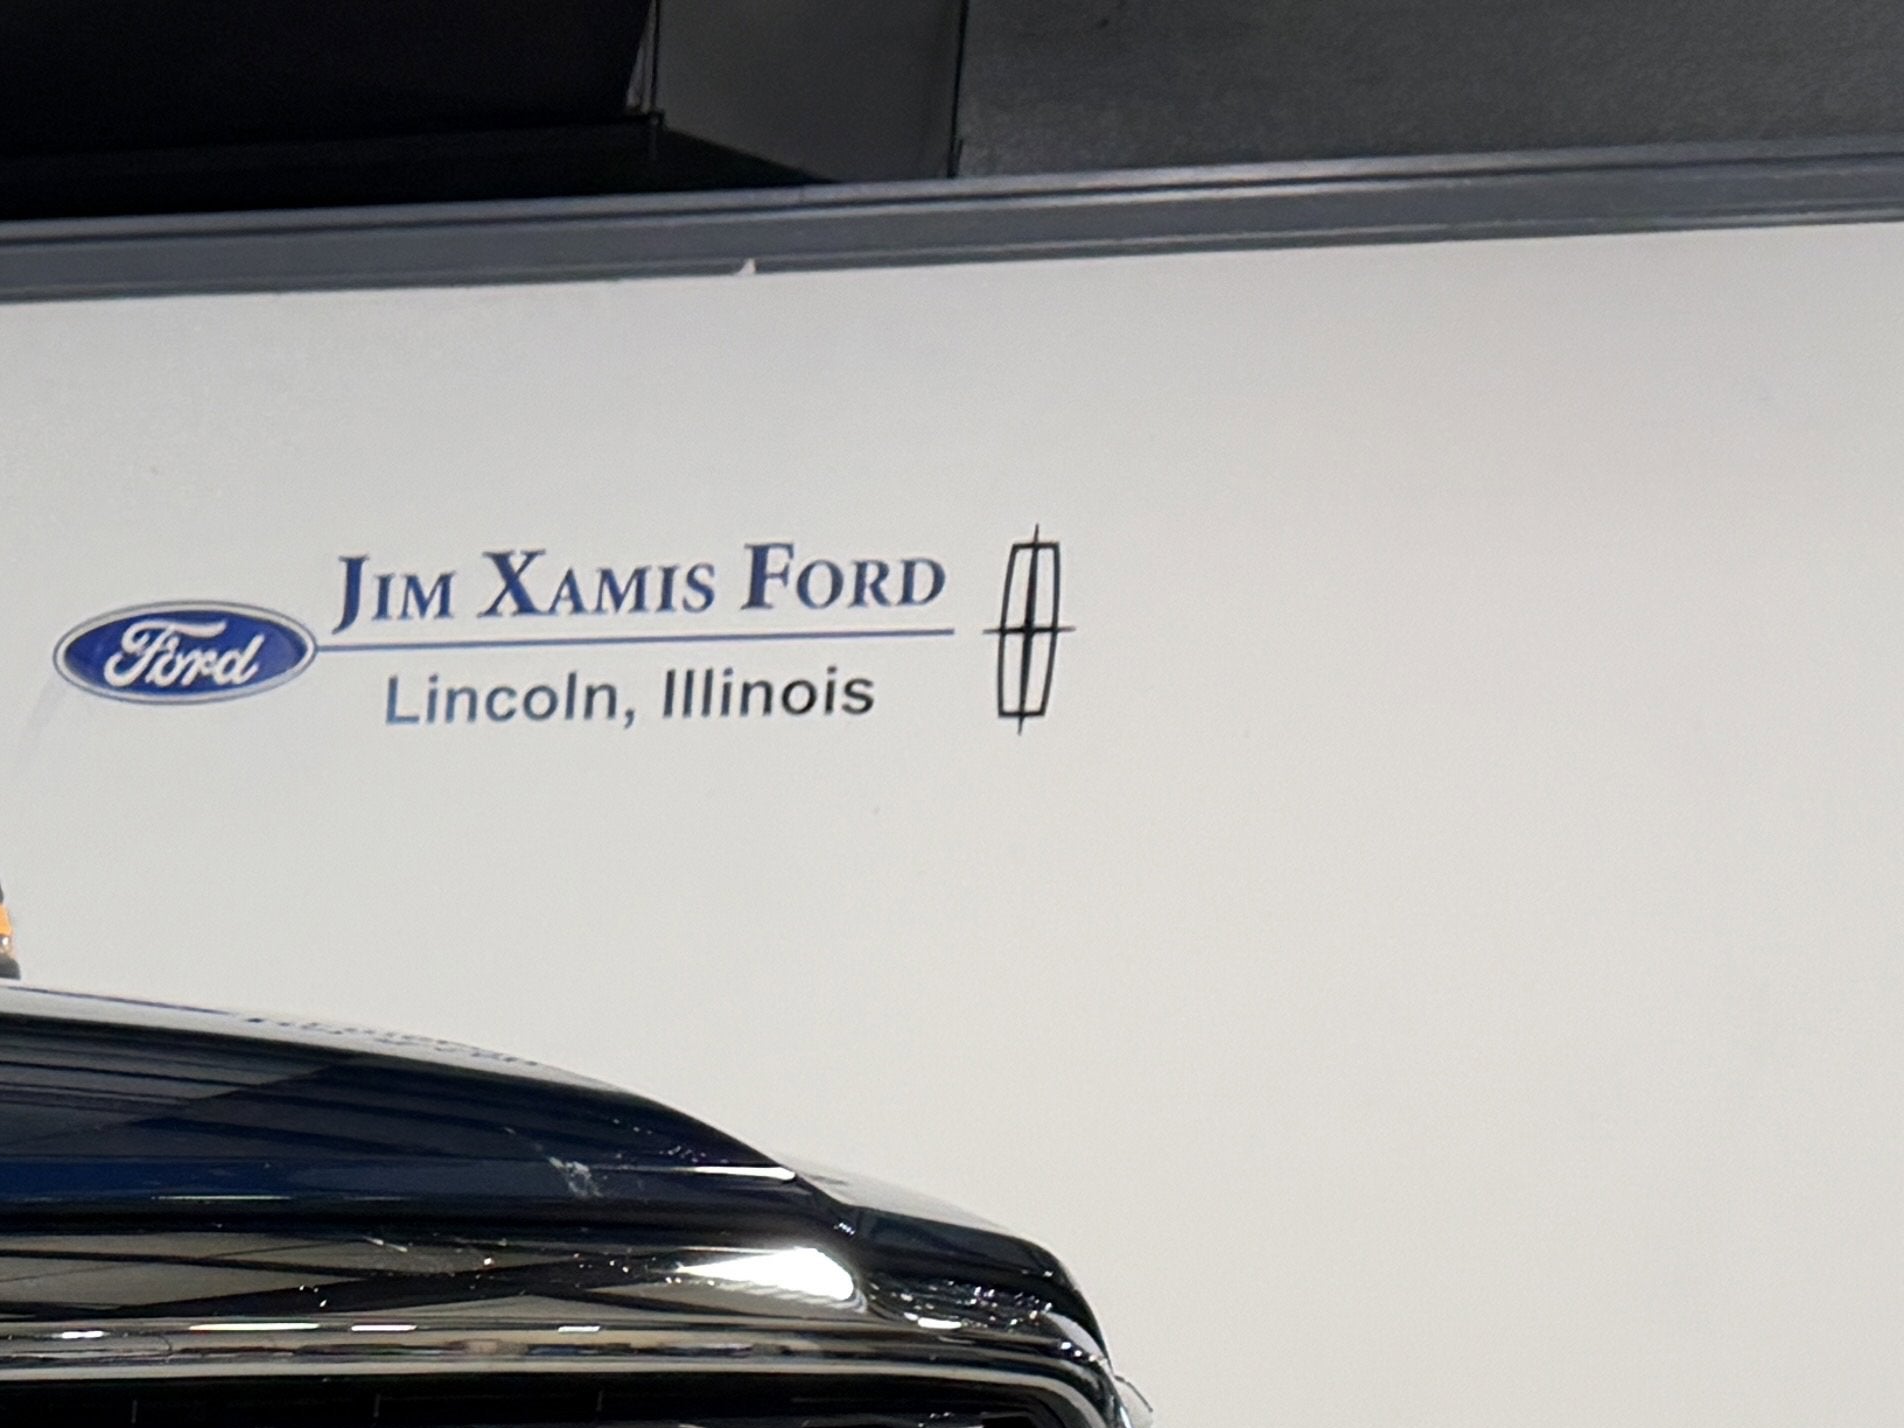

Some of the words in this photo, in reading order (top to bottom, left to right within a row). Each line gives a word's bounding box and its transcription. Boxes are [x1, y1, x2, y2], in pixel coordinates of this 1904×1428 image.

[739, 541, 948, 611] FORD
[103, 618, 266, 690] Ford
[384, 670, 636, 730] Lincoln,
[661, 664, 876, 720] Illinois
